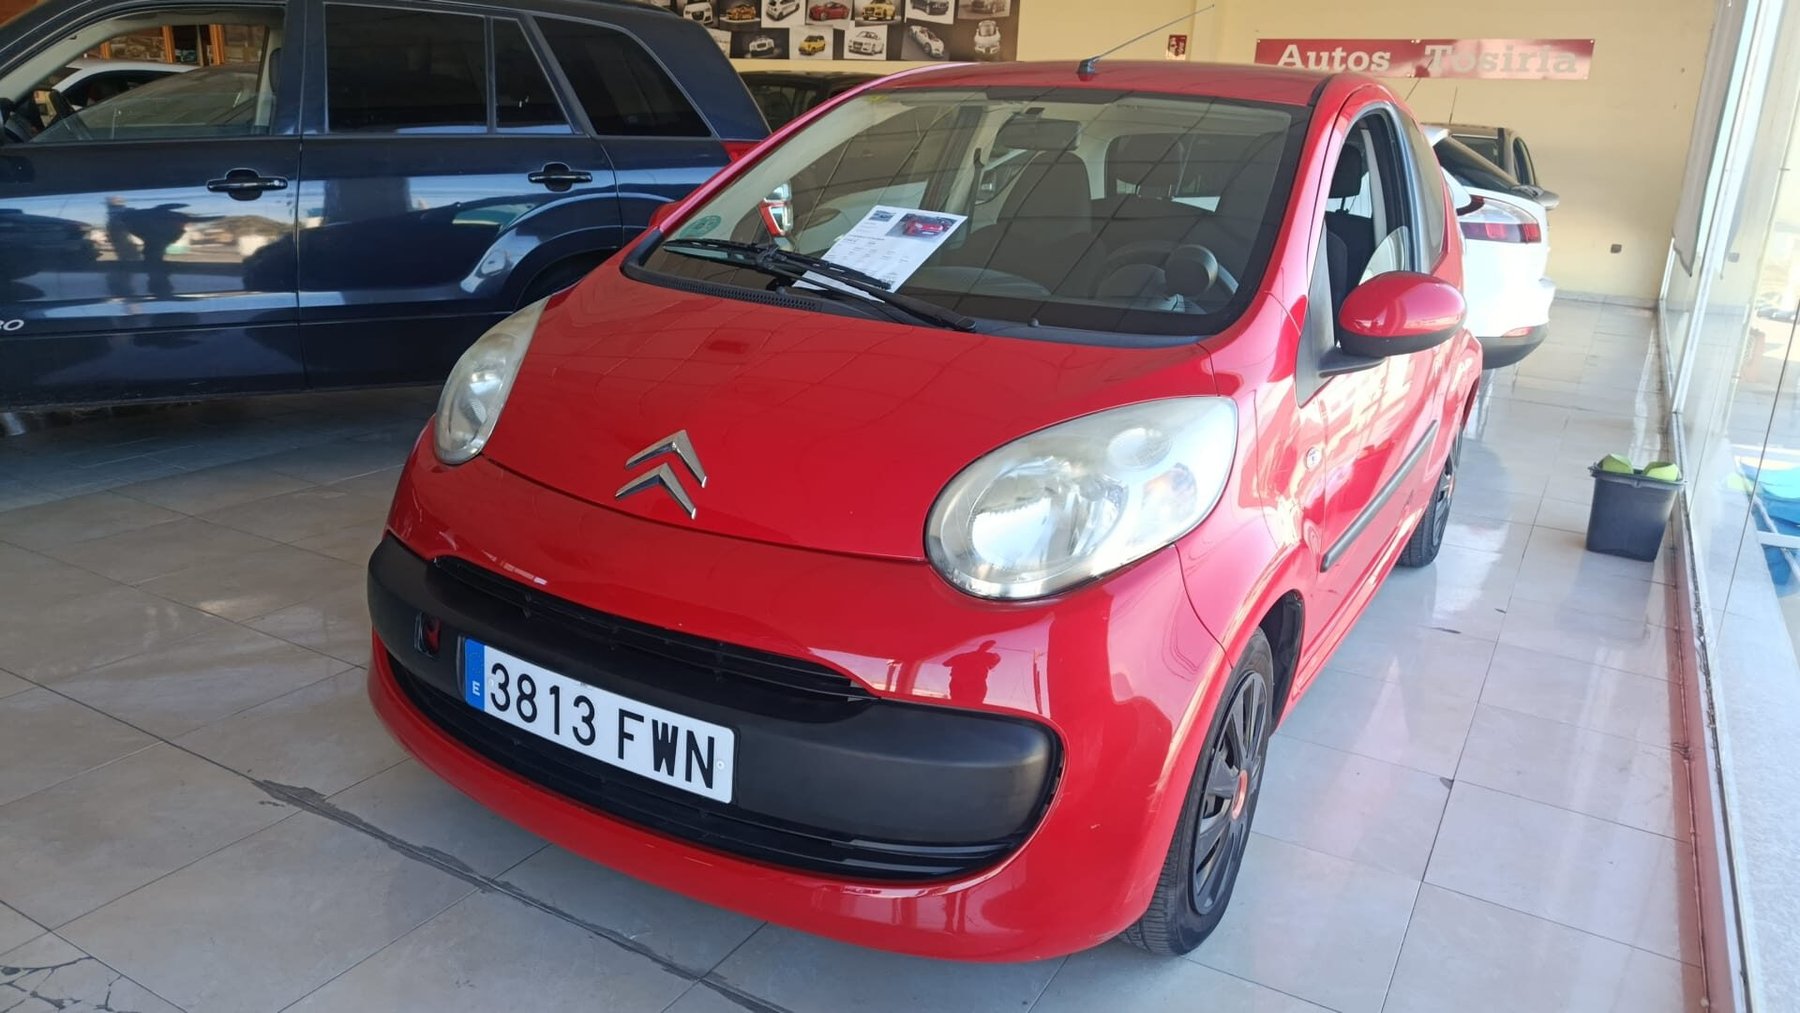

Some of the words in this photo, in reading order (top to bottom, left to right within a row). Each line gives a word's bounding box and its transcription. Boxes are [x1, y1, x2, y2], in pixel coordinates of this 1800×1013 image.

[1277, 44, 1392, 73] Autos
[472, 680, 481, 697] E
[490, 663, 596, 745] 3813
[618, 708, 714, 789] FWN
